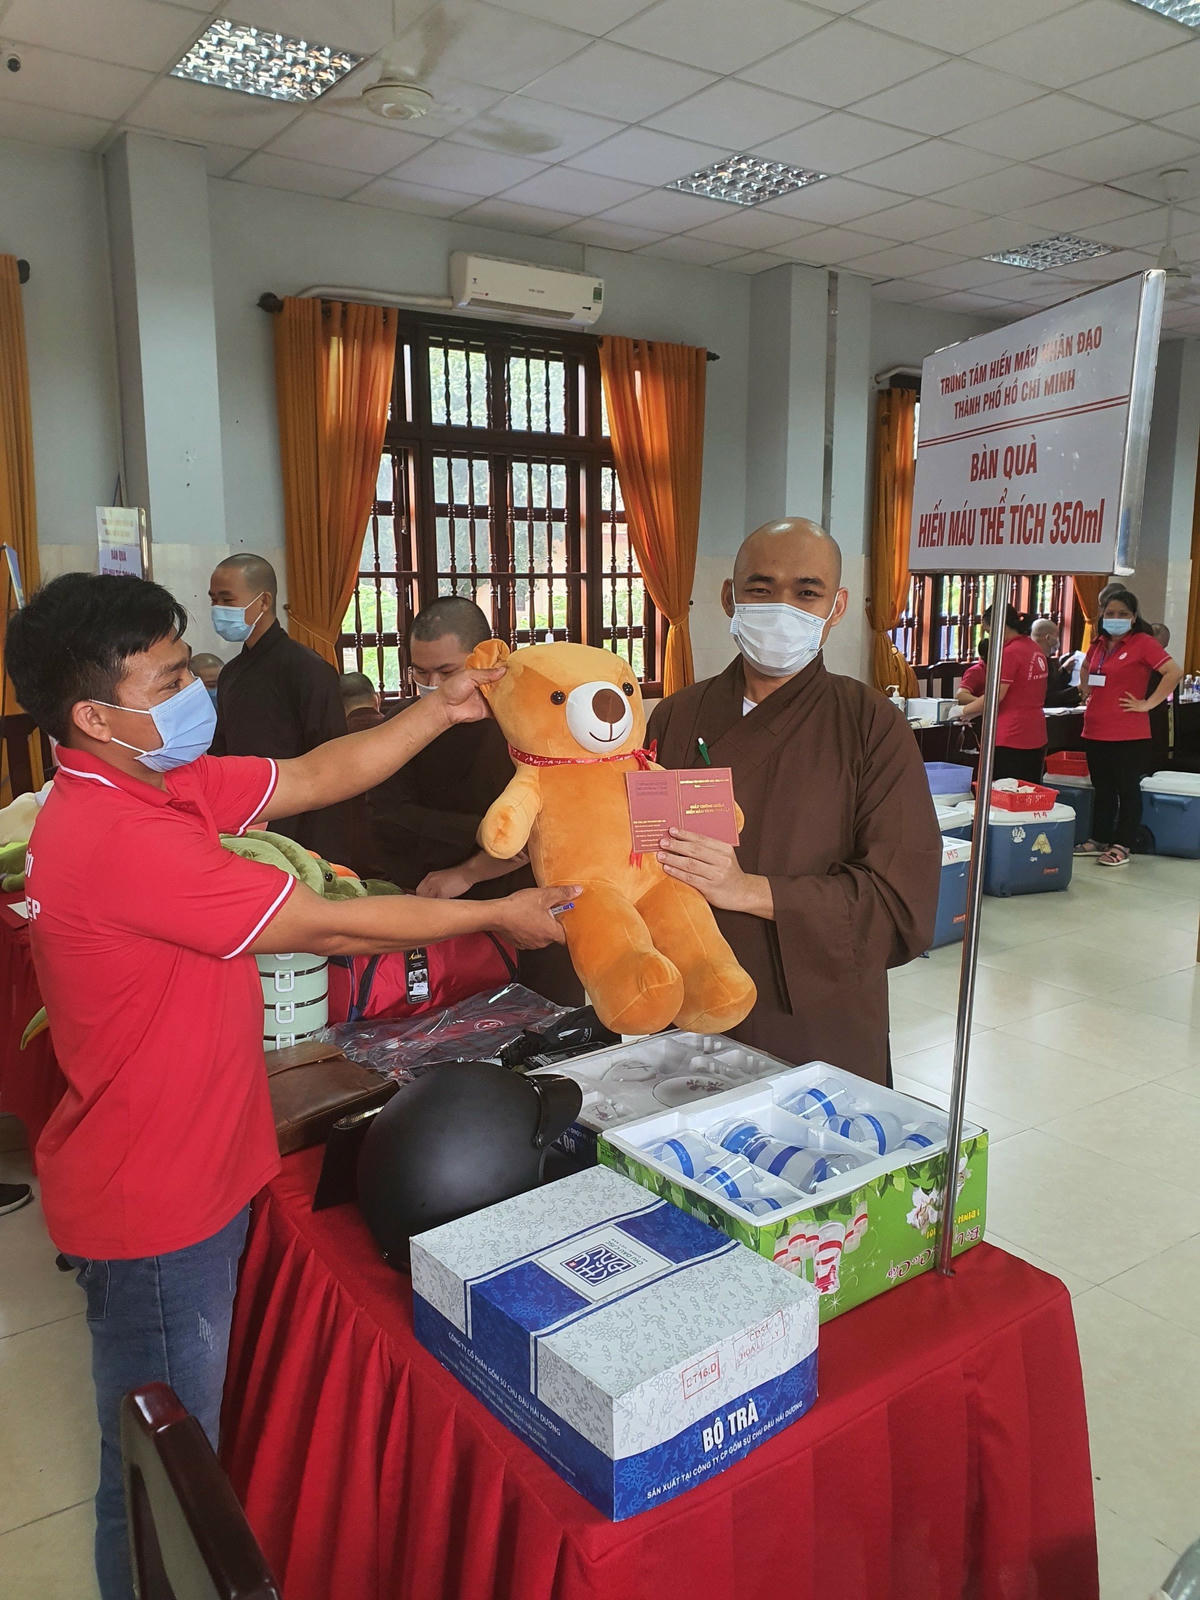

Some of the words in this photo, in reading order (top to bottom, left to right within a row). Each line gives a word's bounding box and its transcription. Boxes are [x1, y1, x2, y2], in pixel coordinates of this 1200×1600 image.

[940, 371, 967, 396] TRUNG
[969, 362, 988, 387] TÂM
[989, 350, 1012, 380] HIẾN
[1014, 344, 1039, 372] MÁU
[1076, 325, 1103, 356] ĐẠO
[954, 395, 981, 420] THÀNH
[983, 381, 1003, 411] PHỐ
[1004, 377, 1019, 406] HỒ
[1021, 373, 1041, 402] CHÍ
[1044, 369, 1076, 397] MINH
[970, 443, 999, 482] BÀN
[1003, 434, 1038, 480] QUÀ
[918, 499, 947, 548] HIẾN
[948, 500, 977, 546] MÁU
[980, 487, 1007, 545] THỂ
[1009, 494, 1047, 545] TÍCH
[1050, 497, 1106, 545] 350ml
[646, 1486, 662, 1499] SẢN
[662, 1477, 681, 1493] XUẤT
[681, 1471, 692, 1482] TẠI
[692, 1461, 711, 1477] CÔNG
[712, 1456, 721, 1467] TY
[720, 1450, 729, 1461] CP
[728, 1440, 742, 1454] GỐM
[743, 1433, 752, 1446] SỨ
[752, 1428, 764, 1441] CHU
[763, 1419, 775, 1433] ĐẬU
[774, 1412, 786, 1425] HẢI
[785, 1400, 803, 1418] DƯƠNG
[702, 1416, 725, 1452] BỘ
[727, 1398, 759, 1436] TRÀ
